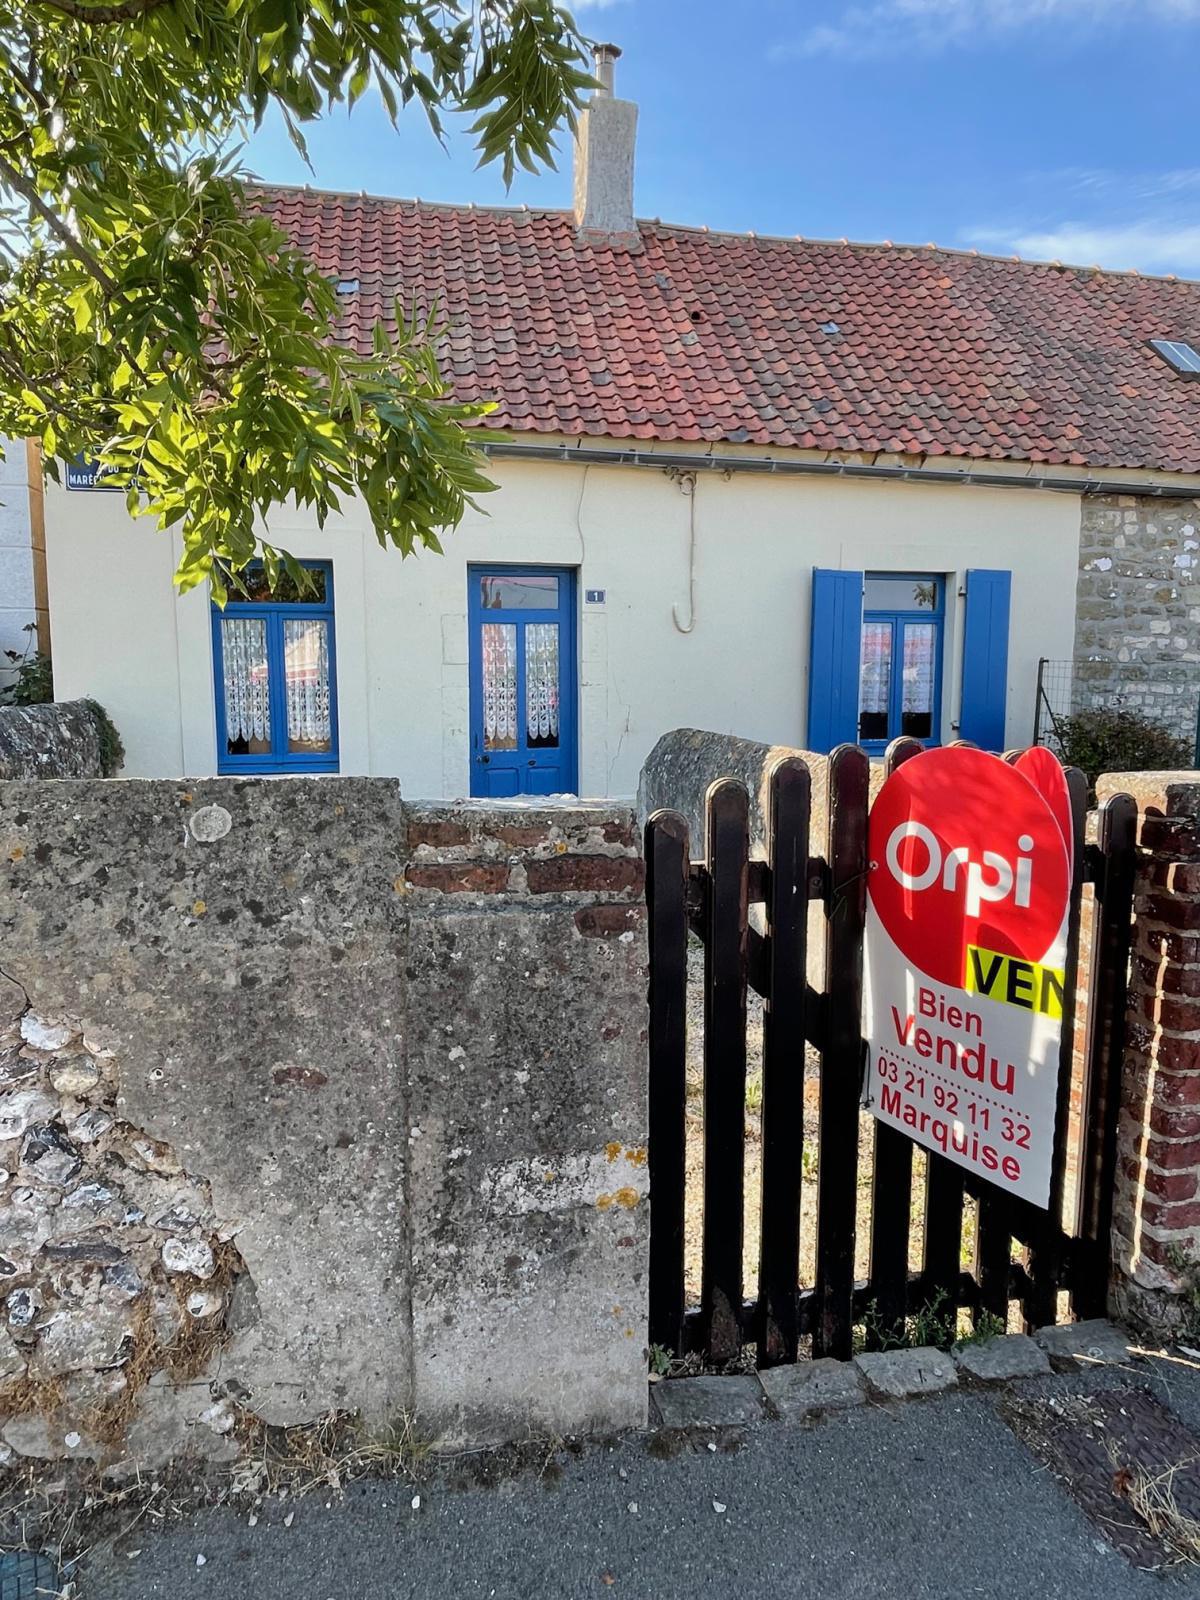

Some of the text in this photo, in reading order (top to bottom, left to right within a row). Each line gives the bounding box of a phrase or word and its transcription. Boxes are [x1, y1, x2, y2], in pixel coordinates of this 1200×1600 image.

[593, 591, 599, 601] 1
[886, 820, 1034, 918] Orpi
[891, 1005, 1016, 1096] Vendu
[918, 986, 983, 1038] Bien
[878, 1056, 1032, 1151] 03 21 92 11 32
[880, 1083, 1021, 1182] Marquise
